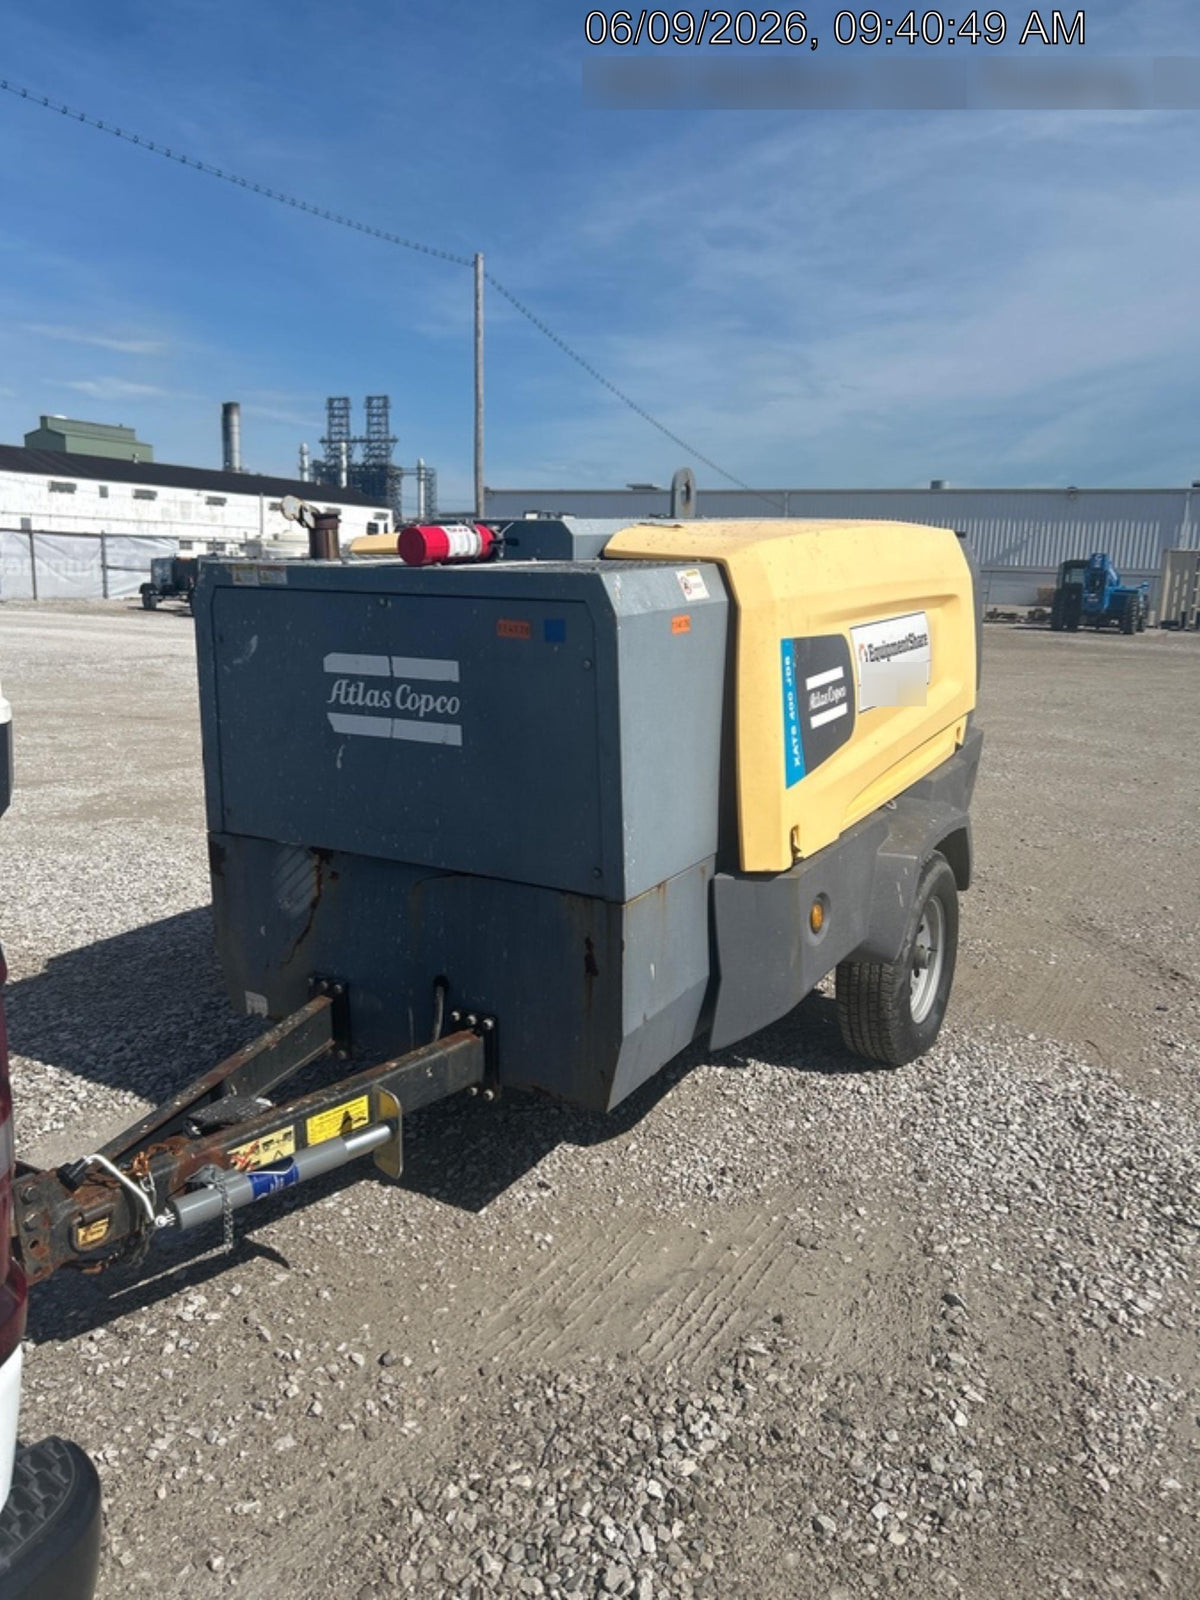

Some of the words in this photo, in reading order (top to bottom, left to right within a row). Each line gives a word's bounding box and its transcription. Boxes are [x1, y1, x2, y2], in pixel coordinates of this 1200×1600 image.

[326, 679, 392, 708] Atlas
[395, 683, 460, 717] Copco
[808, 691, 828, 712] Atlas
[827, 686, 847, 704] Copco
